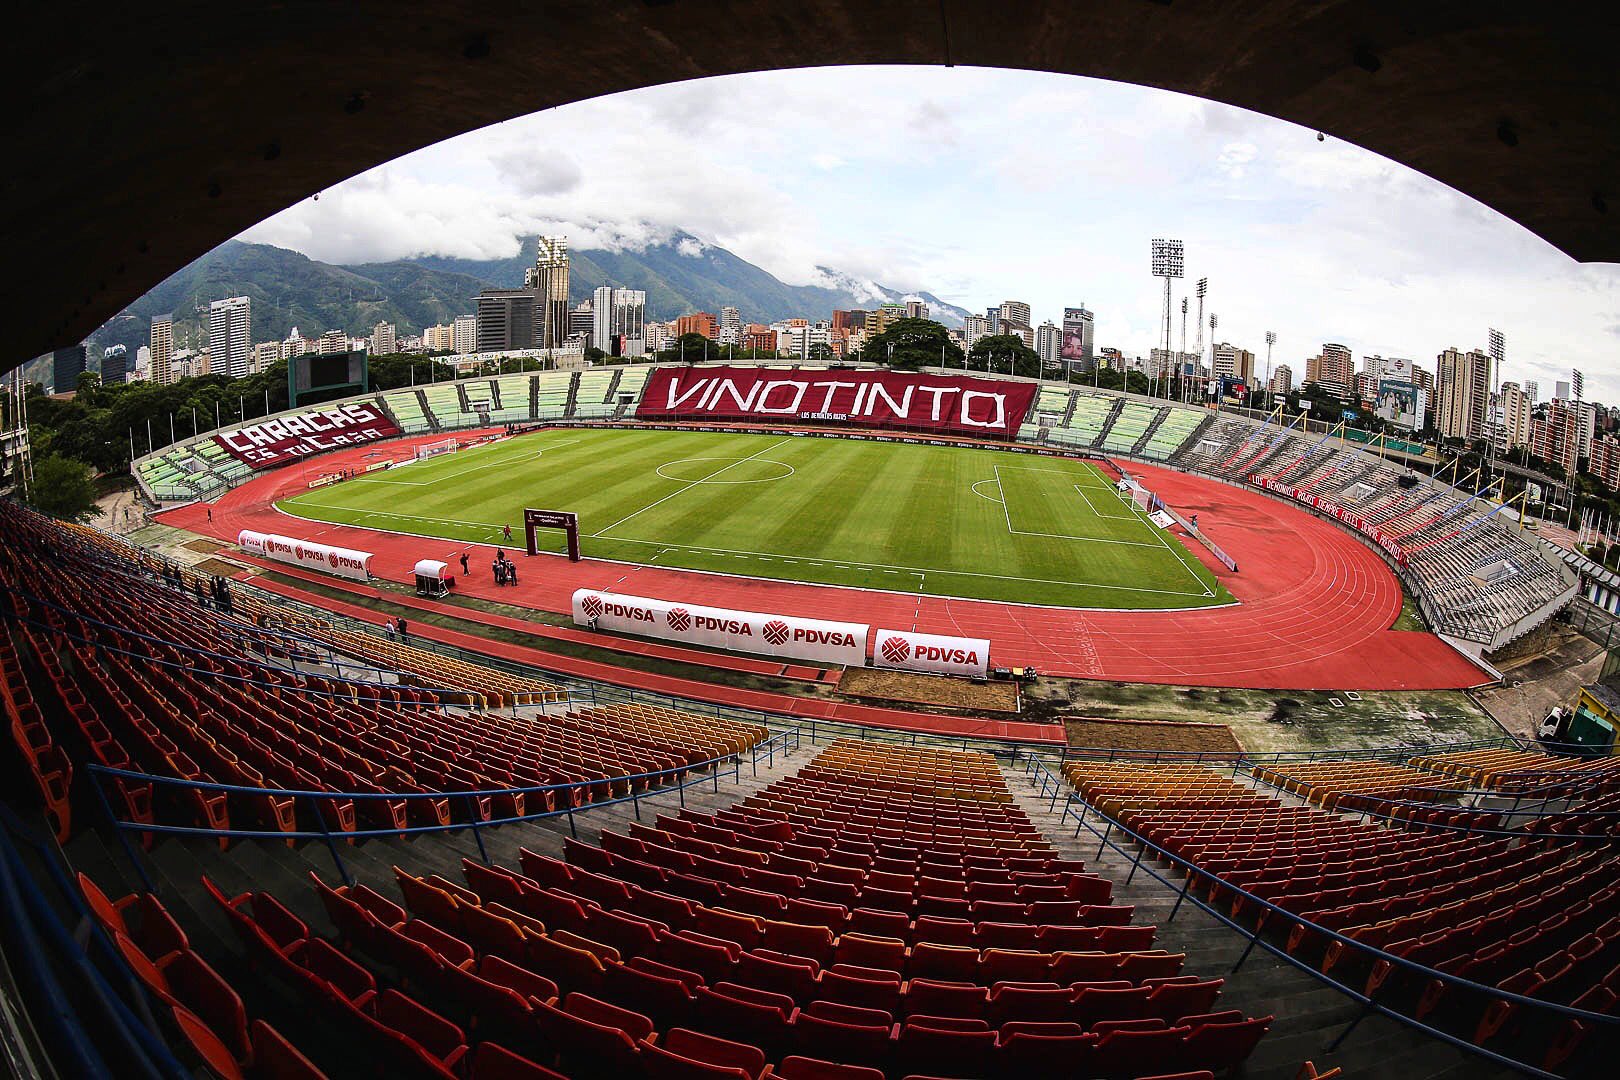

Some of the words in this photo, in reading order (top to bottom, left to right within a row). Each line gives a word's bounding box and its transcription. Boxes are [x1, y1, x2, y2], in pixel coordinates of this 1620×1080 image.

[665, 377, 1007, 429] VINOTINTO
[218, 404, 378, 452] CARACAS
[244, 447, 280, 463] ES
[284, 443, 314, 456] TU
[302, 428, 383, 450] CASA
[1252, 474, 1264, 486] LOS
[1266, 479, 1296, 497] DEMONIOS
[1296, 489, 1316, 505] ROJOS
[274, 542, 293, 554] PDVSA
[304, 549, 325, 562] PDVSA
[338, 556, 364, 570] PDVSA
[604, 602, 656, 623] PDVSA
[695, 615, 753, 637] PDVSA
[793, 628, 857, 648] PDVSA
[914, 645, 979, 666] PDVSA
